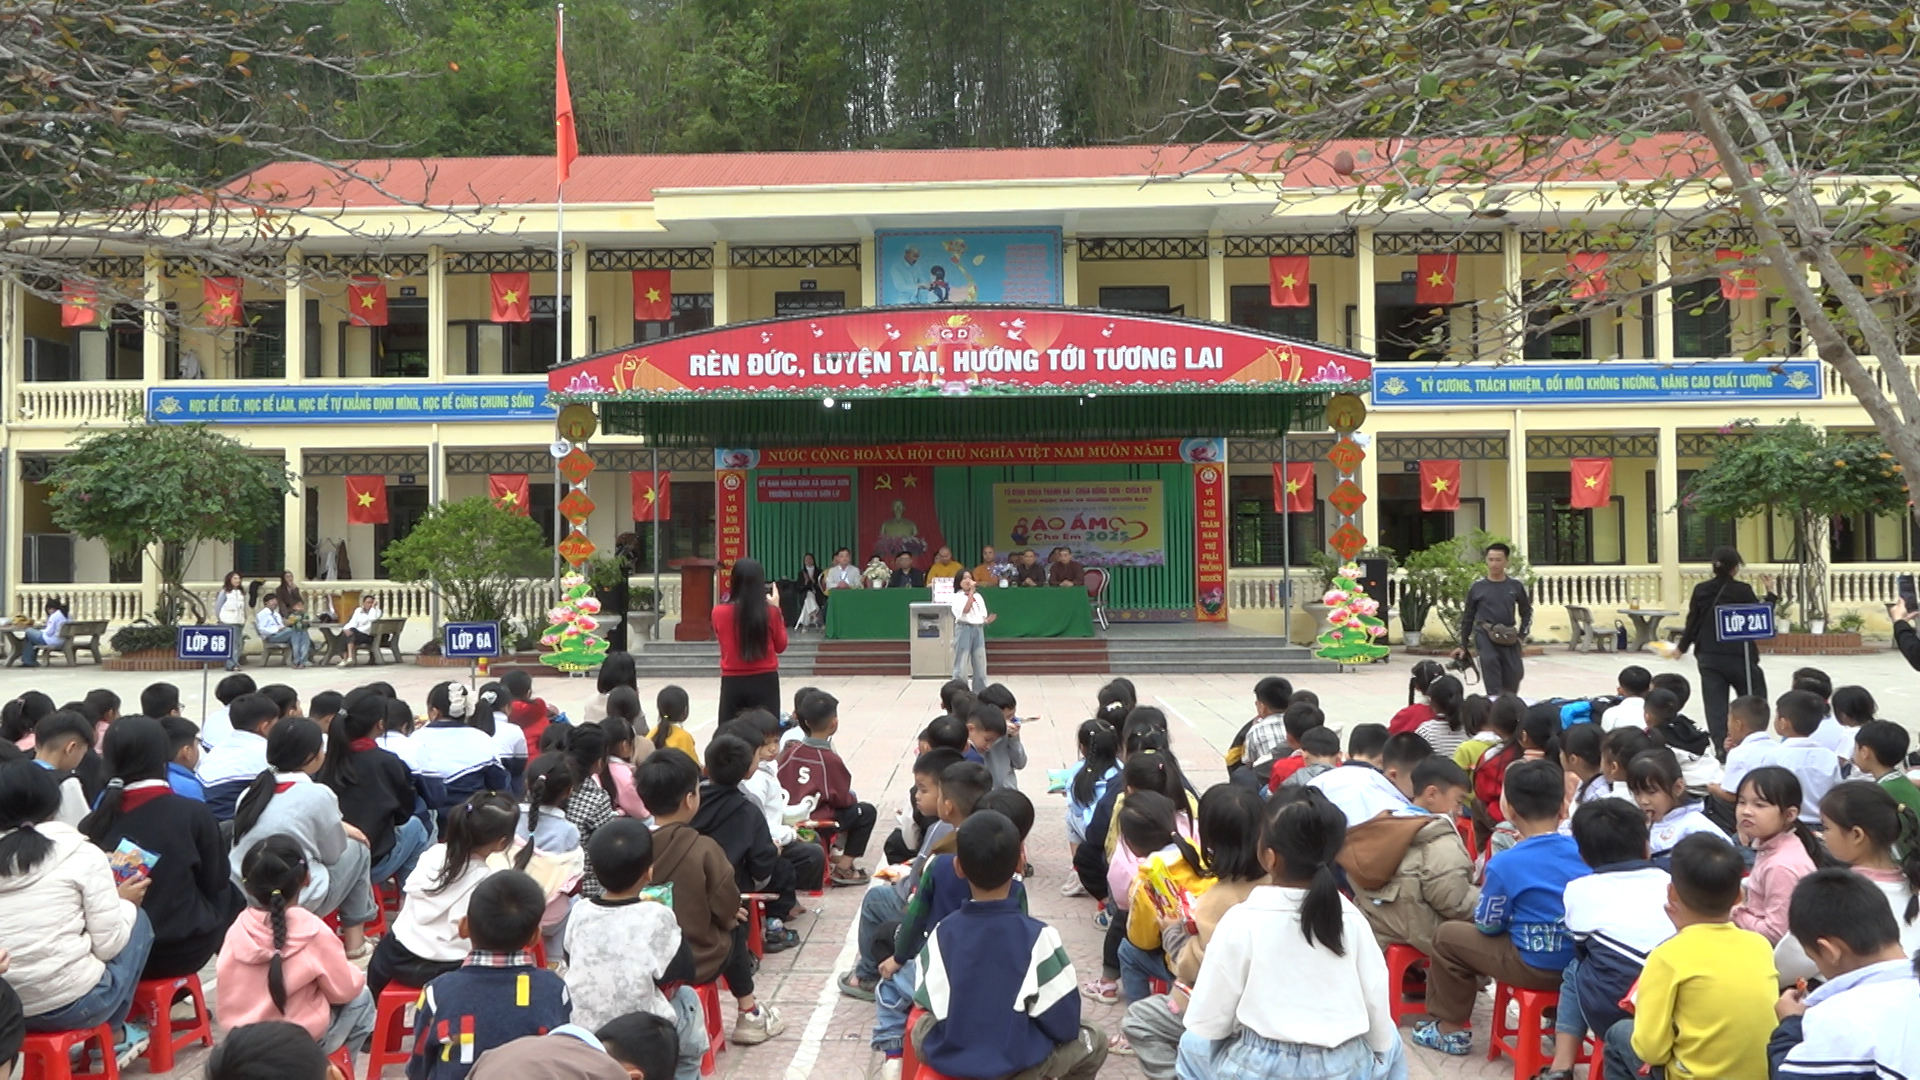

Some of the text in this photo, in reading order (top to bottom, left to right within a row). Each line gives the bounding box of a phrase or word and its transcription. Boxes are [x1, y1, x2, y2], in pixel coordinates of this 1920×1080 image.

[689, 343, 1223, 379] RÈN ĐỨC, LUYỆN TÀI, HƯỚNG TỚI TƯƠNG LAI
[1475, 375, 1506, 392] TRÁCH
[1509, 375, 1544, 394] NHIỆM,
[1565, 374, 1584, 391] MỚI
[1586, 374, 1620, 390] KHÔNG
[1661, 372, 1690, 389] NÂNG
[1691, 373, 1711, 389] CAO
[1712, 370, 1738, 389] CHẤT
[189, 398, 206, 415] HỌC
[244, 398, 261, 415] HỌC
[298, 397, 316, 414] HỌC
[342, 392, 372, 410] KHẲNG
[373, 396, 394, 414] ĐỊNH
[423, 396, 440, 412] HỌC
[455, 393, 478, 409] CÙNG
[480, 394, 509, 408] CHUNG
[511, 389, 535, 408] SỐNG
[768, 448, 808, 462] NƯỚC
[811, 447, 850, 464] CỘNG
[885, 446, 905, 460] XÃ
[907, 445, 933, 462] HỘI
[936, 443, 967, 460] CHỦ
[969, 444, 1015, 459] NGHĨA
[1018, 444, 1051, 460] VIỆT
[1053, 446, 1085, 458] NAM
[1087, 443, 1131, 457] MUÔN
[1133, 442, 1165, 456] NĂM
[1724, 611, 1768, 632] LỚP 2A1
[185, 631, 226, 652] LỚP 6B
[452, 629, 492, 650] LỚP 6A
[797, 765, 811, 785] S
